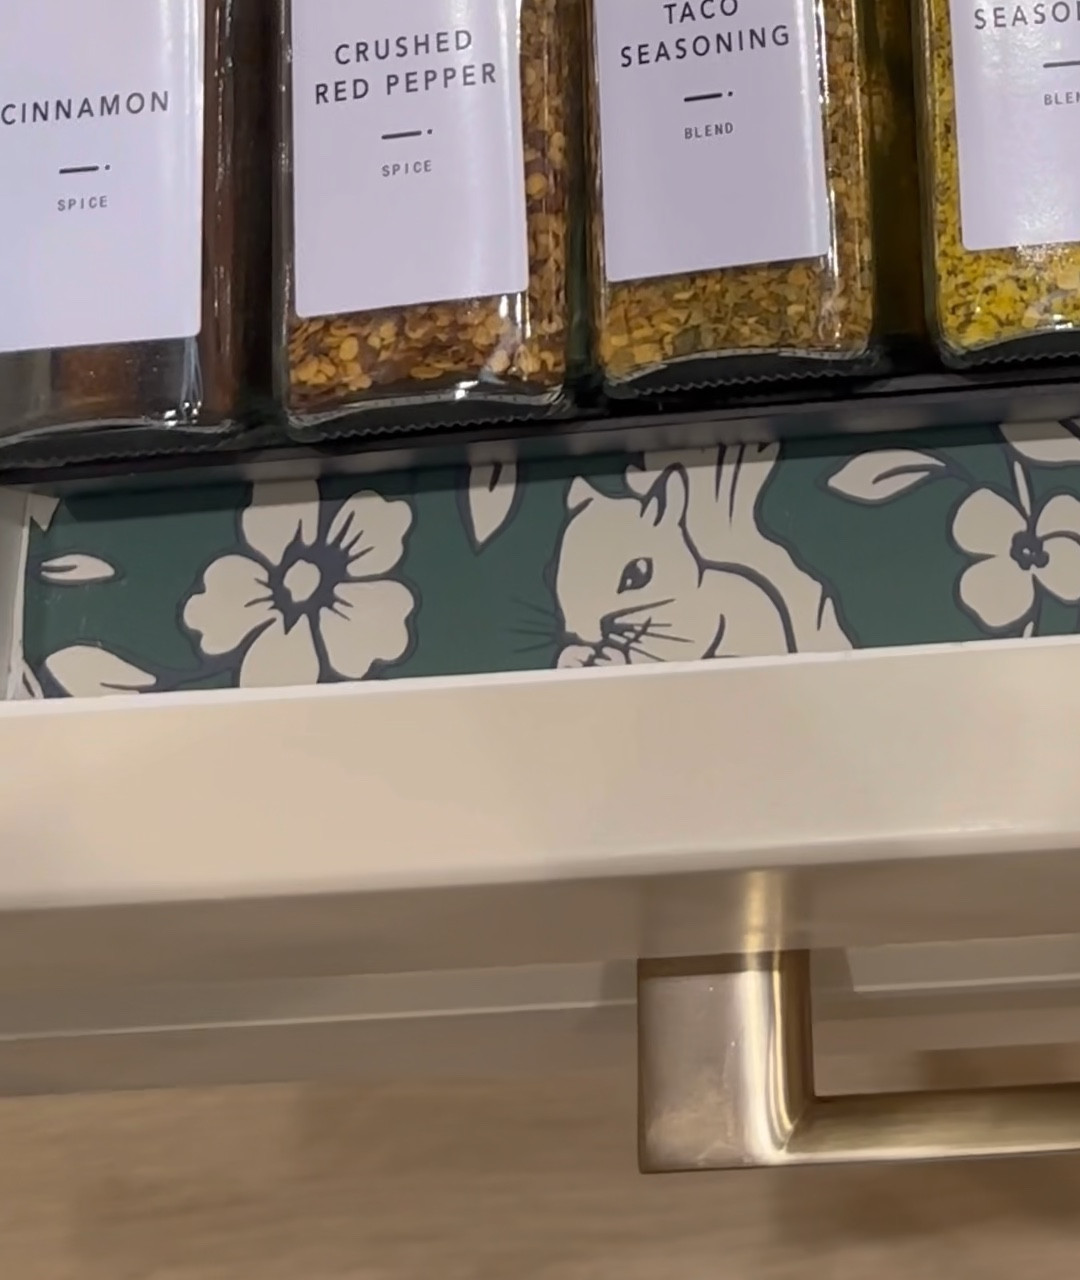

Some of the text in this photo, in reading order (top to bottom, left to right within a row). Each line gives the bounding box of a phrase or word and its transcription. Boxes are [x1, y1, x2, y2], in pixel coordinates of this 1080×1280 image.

[334, 29, 472, 66] CRUSHED
[620, 24, 790, 68] SEASONING
[315, 61, 497, 105] RED PEPPER
[0, 90, 169, 126] CINNAMON
[684, 121, 734, 140] BLEND
[381, 159, 432, 178] SPICE
[57, 194, 108, 212] SPICE
